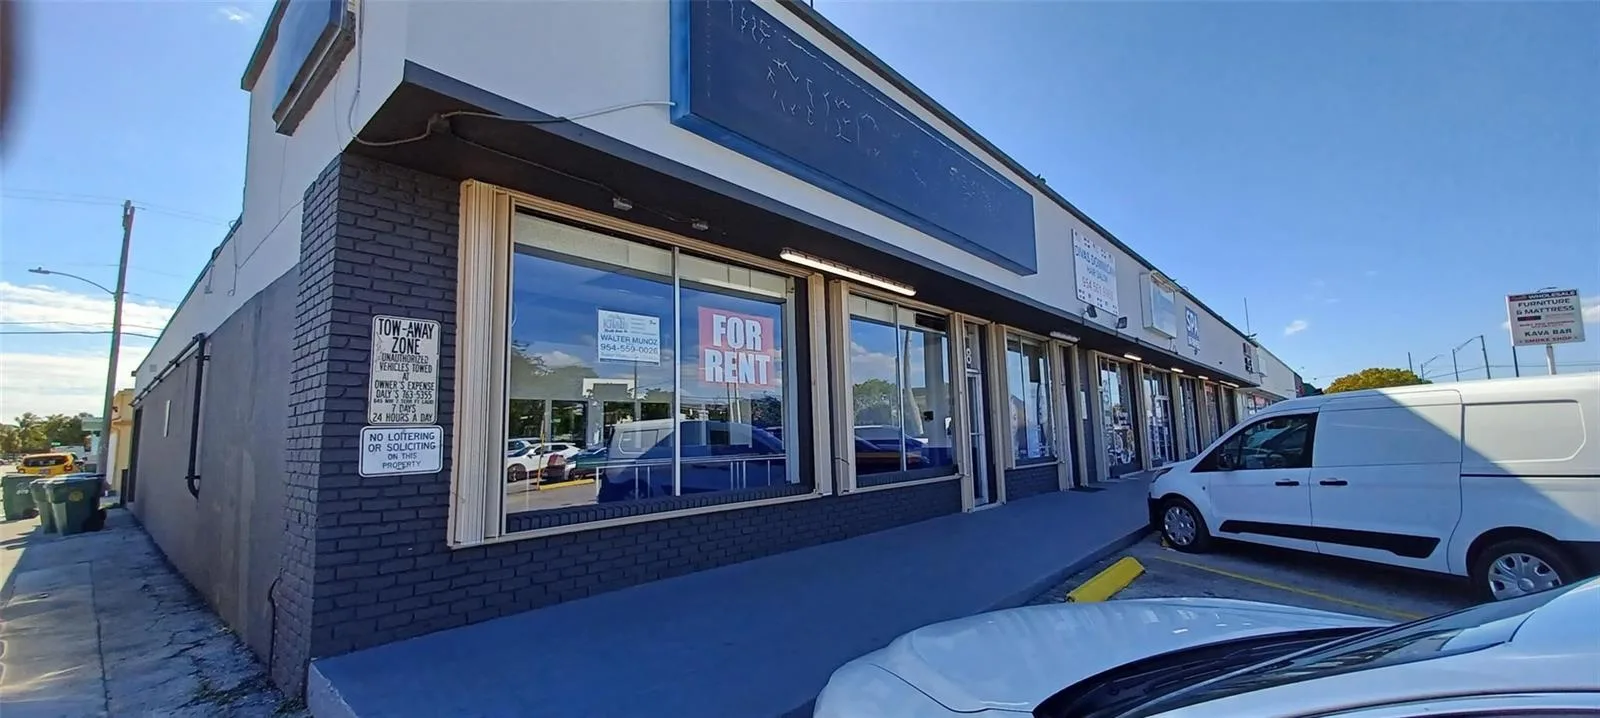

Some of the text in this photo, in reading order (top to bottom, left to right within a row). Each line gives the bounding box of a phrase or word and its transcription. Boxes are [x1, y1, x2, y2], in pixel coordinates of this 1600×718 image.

[1518, 298, 1571, 307] FURNITURE
[1525, 305, 1575, 314] MATTRESS
[378, 319, 435, 339] TOW-AWAY
[712, 314, 762, 351] FOR
[600, 333, 631, 342] WALTER
[392, 337, 421, 355] ZONE
[381, 353, 429, 364] UNAUTHORIZED
[380, 362, 433, 373] VEHICLES TOWED
[704, 348, 771, 385] RENT
[402, 372, 410, 381] AT
[407, 381, 434, 391] EXPENSE
[402, 390, 432, 399] 763-5355
[391, 404, 416, 413] 7 DAYS
[372, 413, 433, 422] 24 HOURS A DAY
[369, 432, 435, 441] NO LOITERING
[368, 442, 436, 452] OR SOLICITING
[401, 452, 417, 460] THIS
[382, 460, 421, 469] PROPERTY
